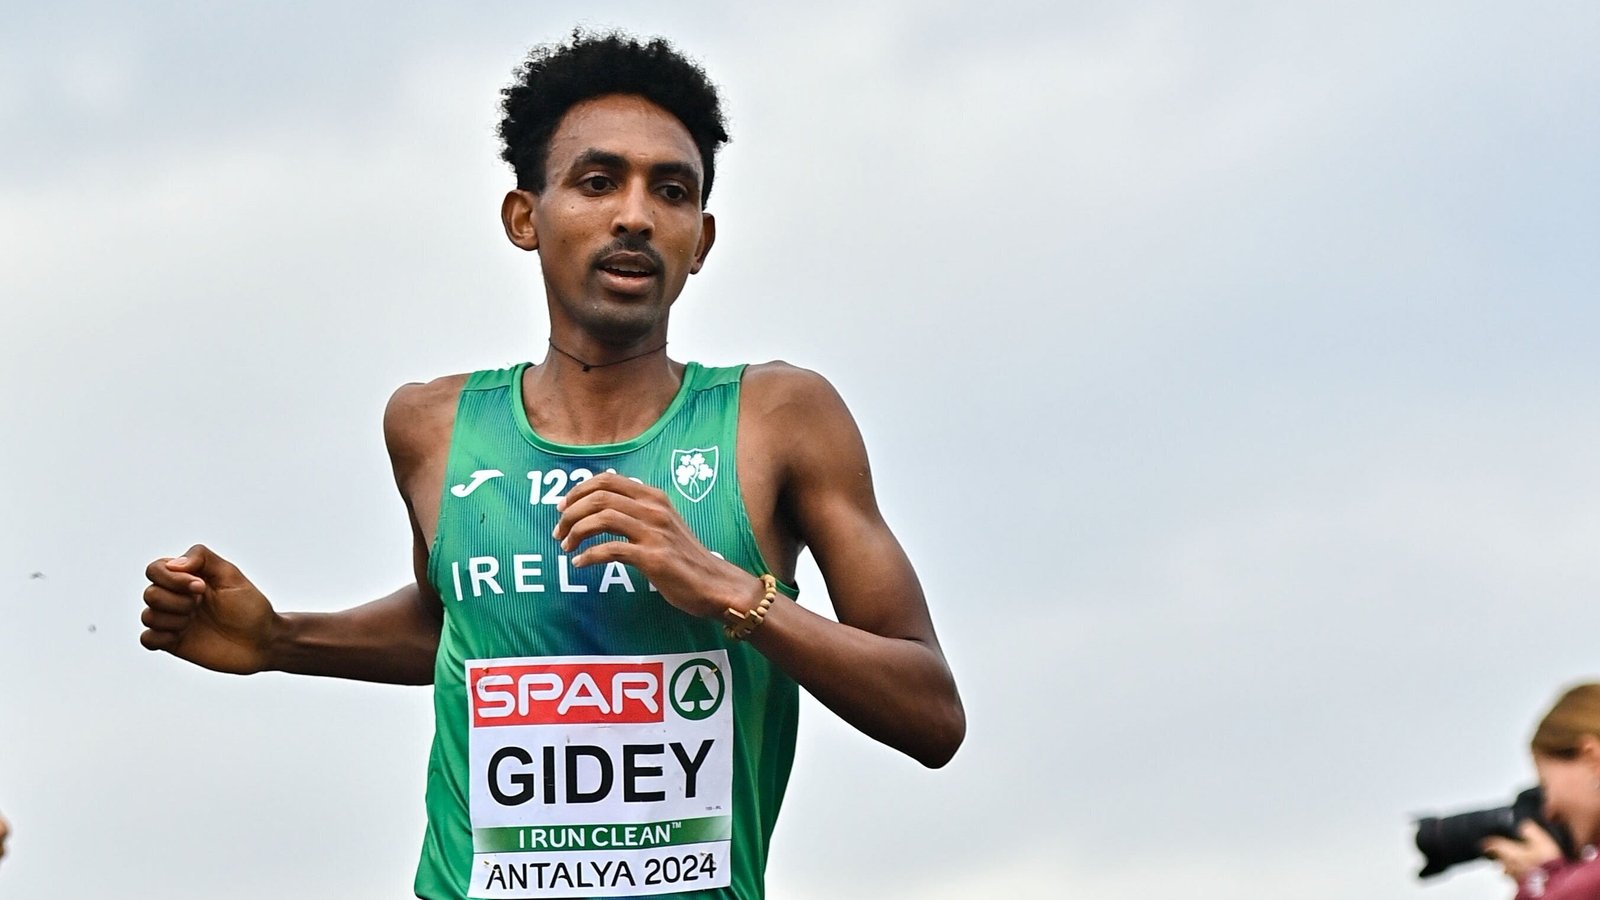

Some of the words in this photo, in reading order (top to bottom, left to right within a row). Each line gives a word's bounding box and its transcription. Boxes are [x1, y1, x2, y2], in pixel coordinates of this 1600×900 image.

[451, 552, 725, 602] IRELA
[476, 672, 659, 717] SPAR
[487, 739, 715, 805] GIDEY
[519, 830, 525, 848] I
[531, 829, 585, 848] RUN
[486, 861, 635, 889] ANTALYA
[645, 853, 717, 884] 2024
